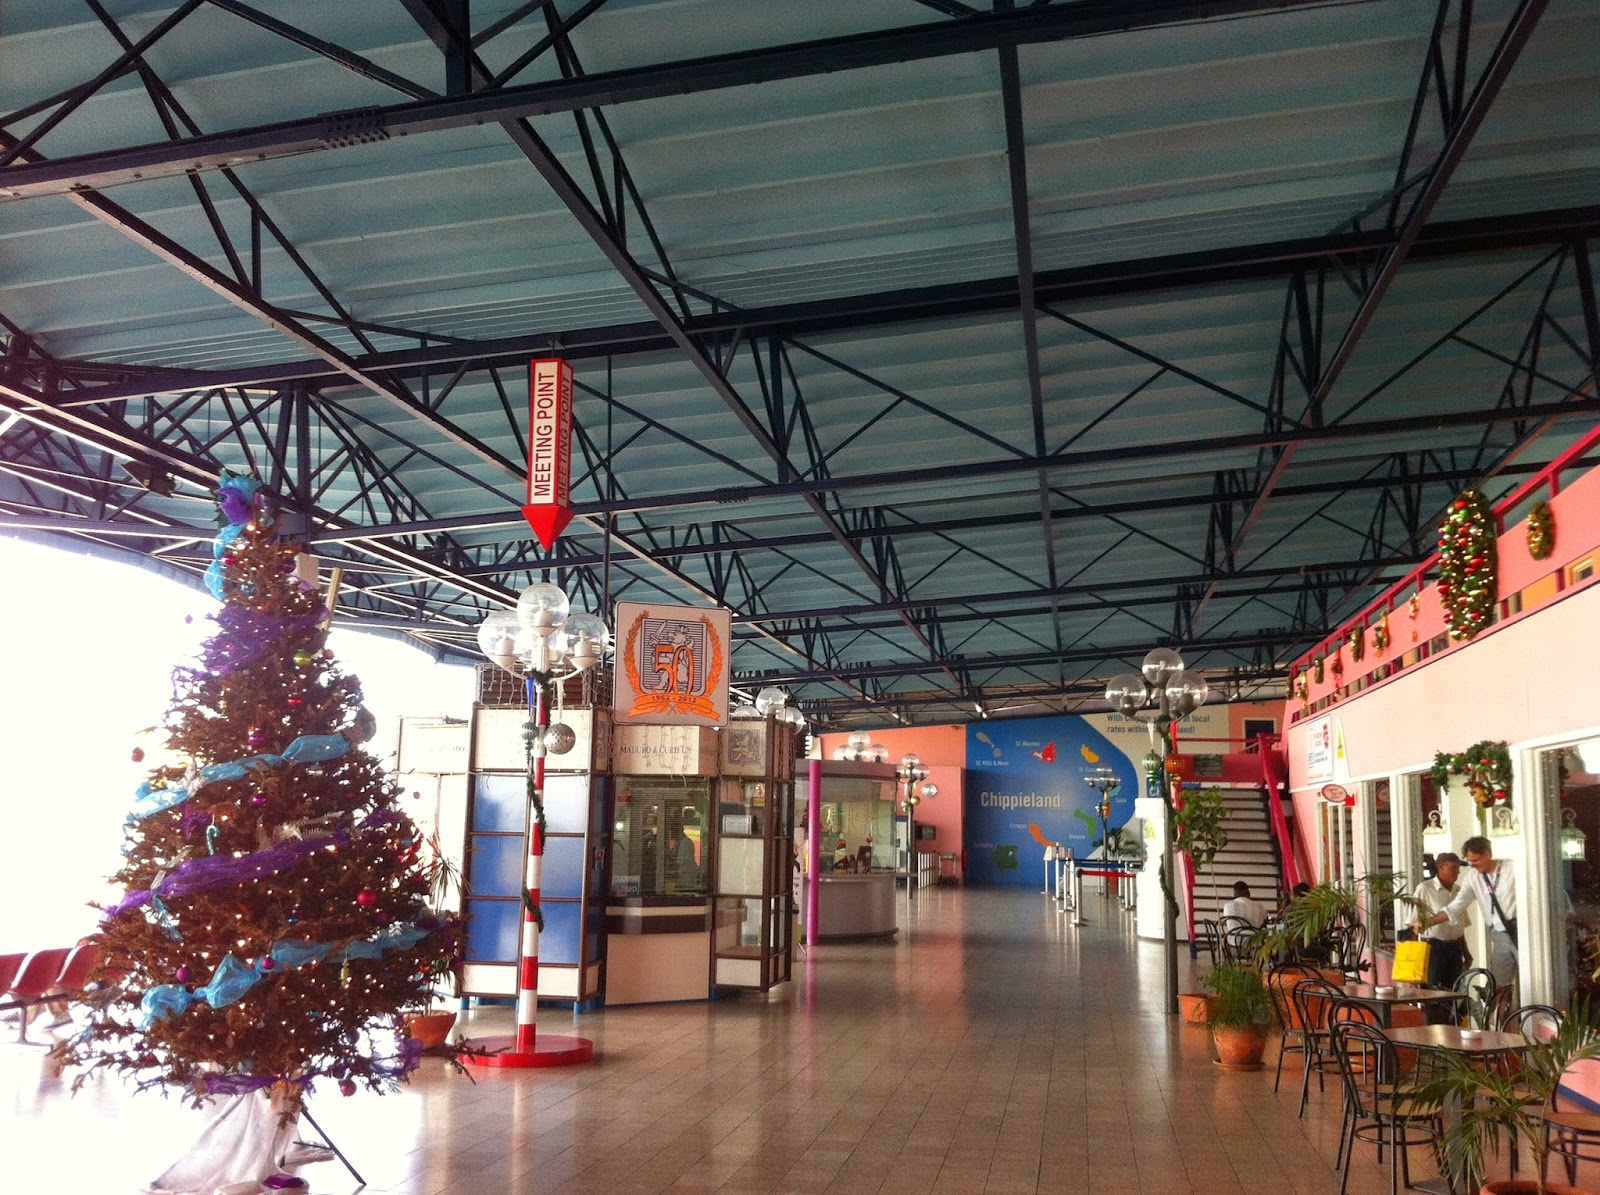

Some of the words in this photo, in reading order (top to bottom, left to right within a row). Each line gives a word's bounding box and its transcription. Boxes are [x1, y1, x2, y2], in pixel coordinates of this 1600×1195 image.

[537, 372, 554, 421] POINT
[560, 376, 571, 424] POINT
[534, 424, 552, 497] MEETING
[558, 428, 569, 500] MEETING
[654, 643, 695, 695] 50
[678, 695, 697, 703] 2012
[1107, 713, 1123, 721] With
[1192, 714, 1210, 722] local
[1107, 726, 1126, 734] rates
[620, 746, 652, 754] MADURO
[980, 790, 1061, 811] Chippieland
